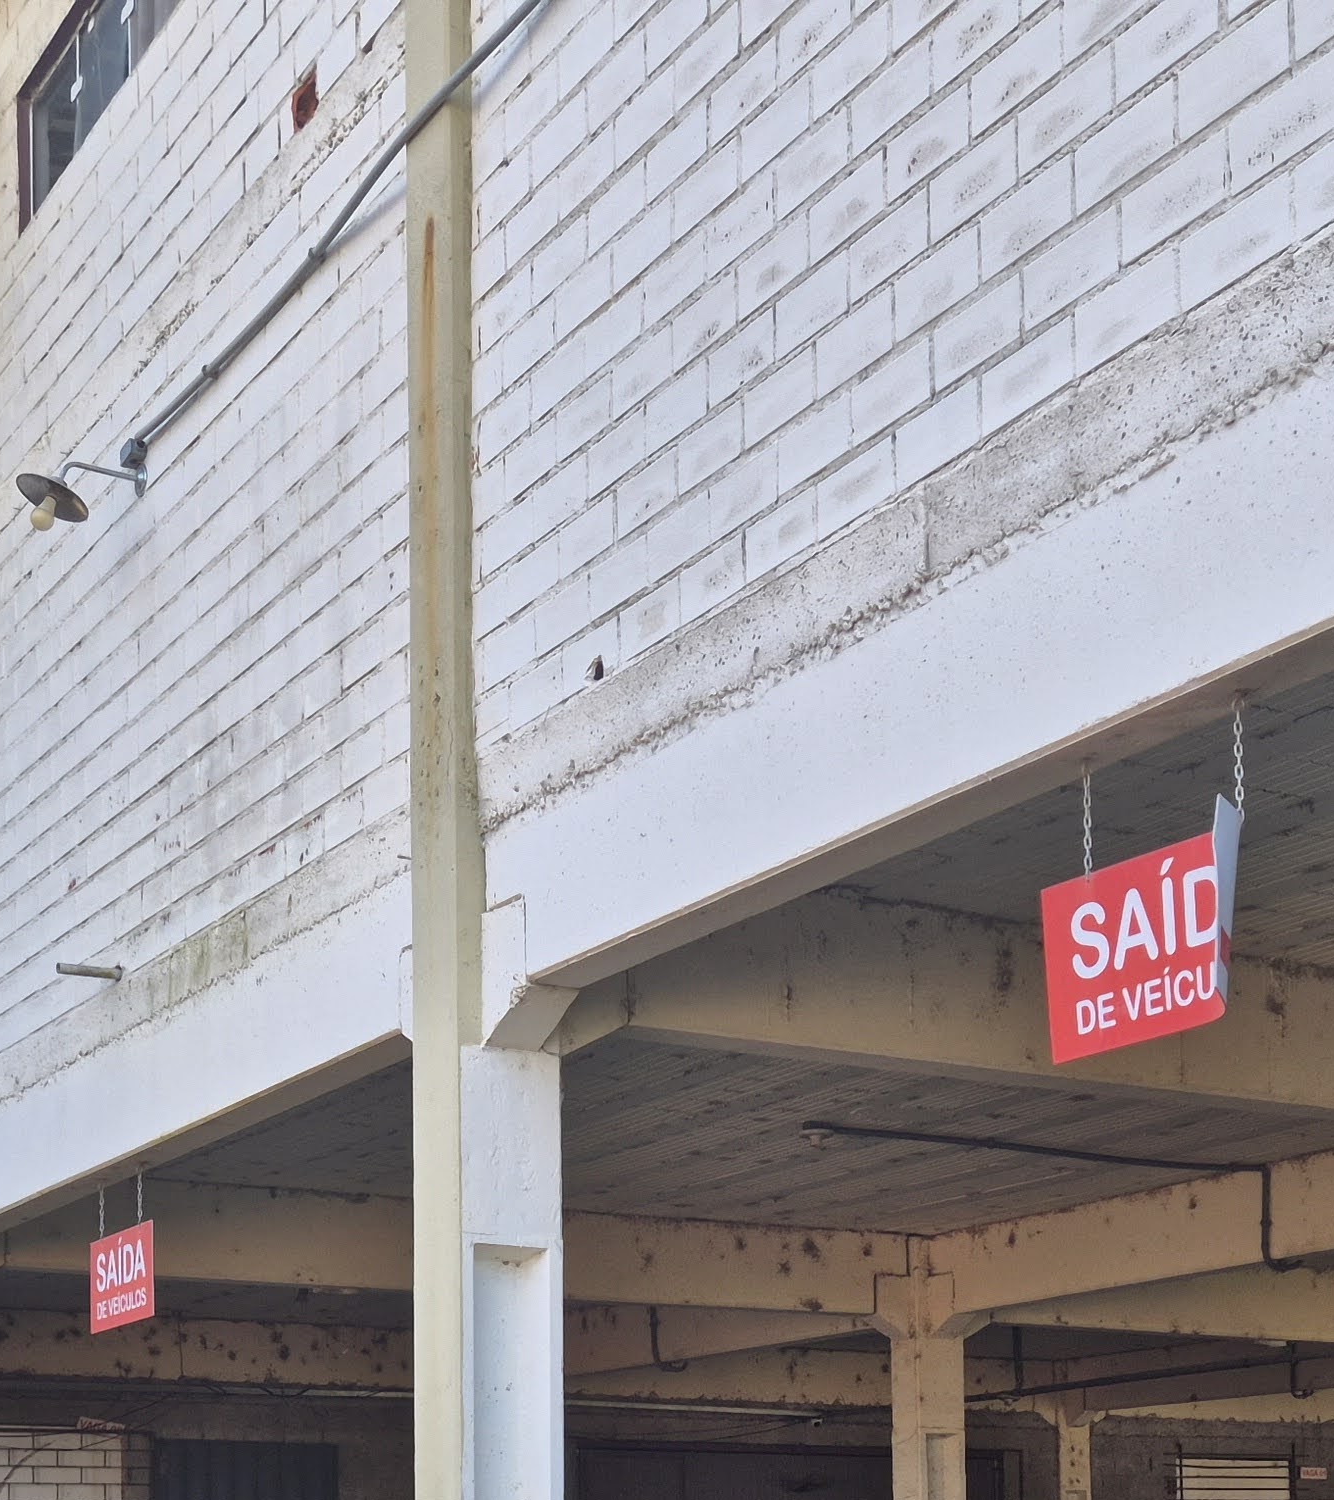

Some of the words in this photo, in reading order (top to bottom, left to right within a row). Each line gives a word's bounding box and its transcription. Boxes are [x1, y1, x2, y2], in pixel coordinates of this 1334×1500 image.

[1076, 992, 1116, 1035] DE
[96, 1236, 146, 1292] SAÍDA
[97, 1300, 107, 1320] DE
[108, 1287, 147, 1316] VEÍCULOS
